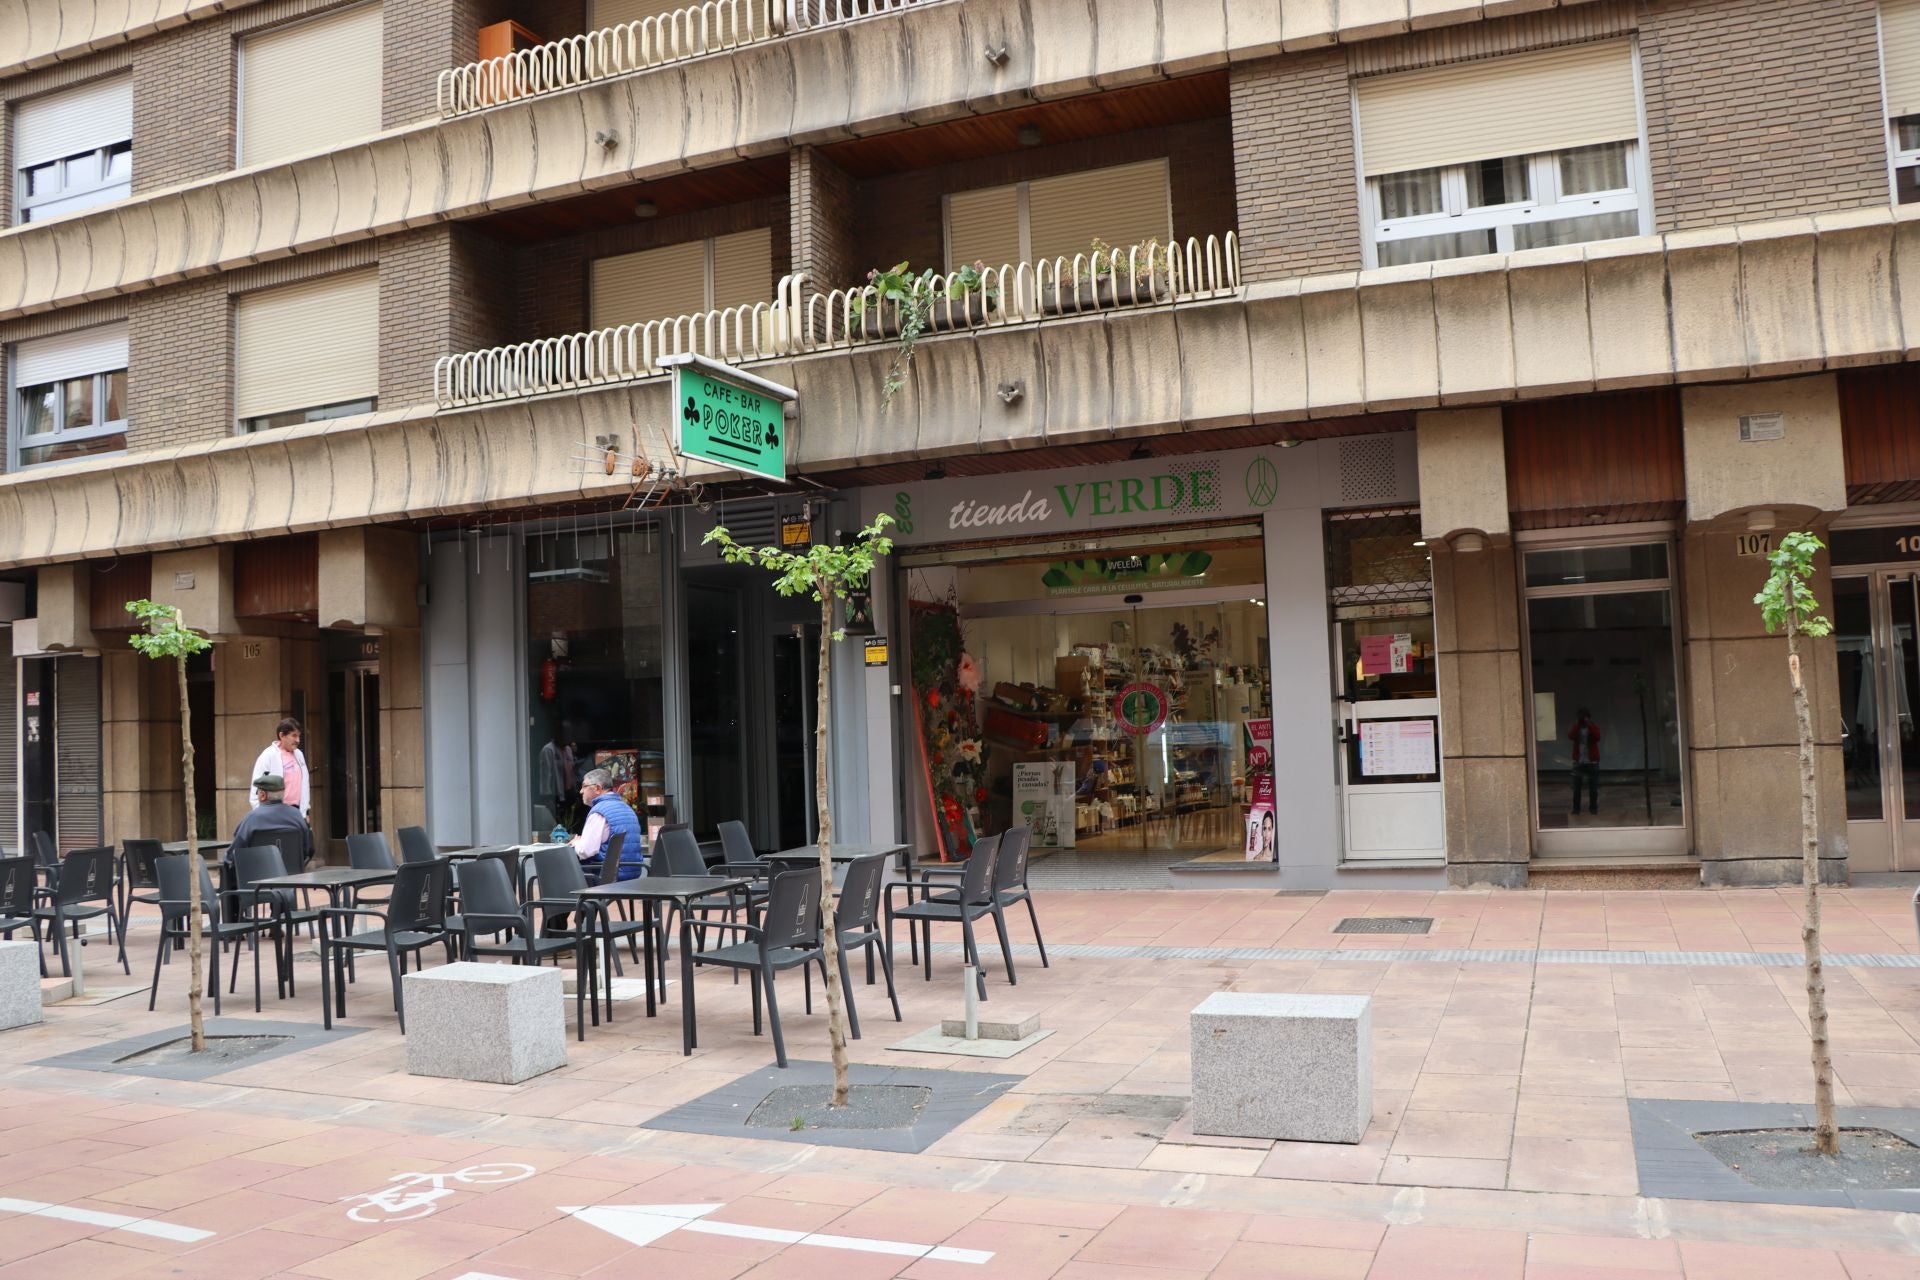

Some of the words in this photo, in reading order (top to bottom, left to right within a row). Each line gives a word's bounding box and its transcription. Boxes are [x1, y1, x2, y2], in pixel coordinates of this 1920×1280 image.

[703, 404, 763, 446] POKER
[949, 489, 1053, 531] tienda
[1054, 469, 1218, 519] VERDE
[1738, 534, 1770, 554] 107
[1107, 560, 1143, 571] WELEDA
[244, 644, 260, 658] 105
